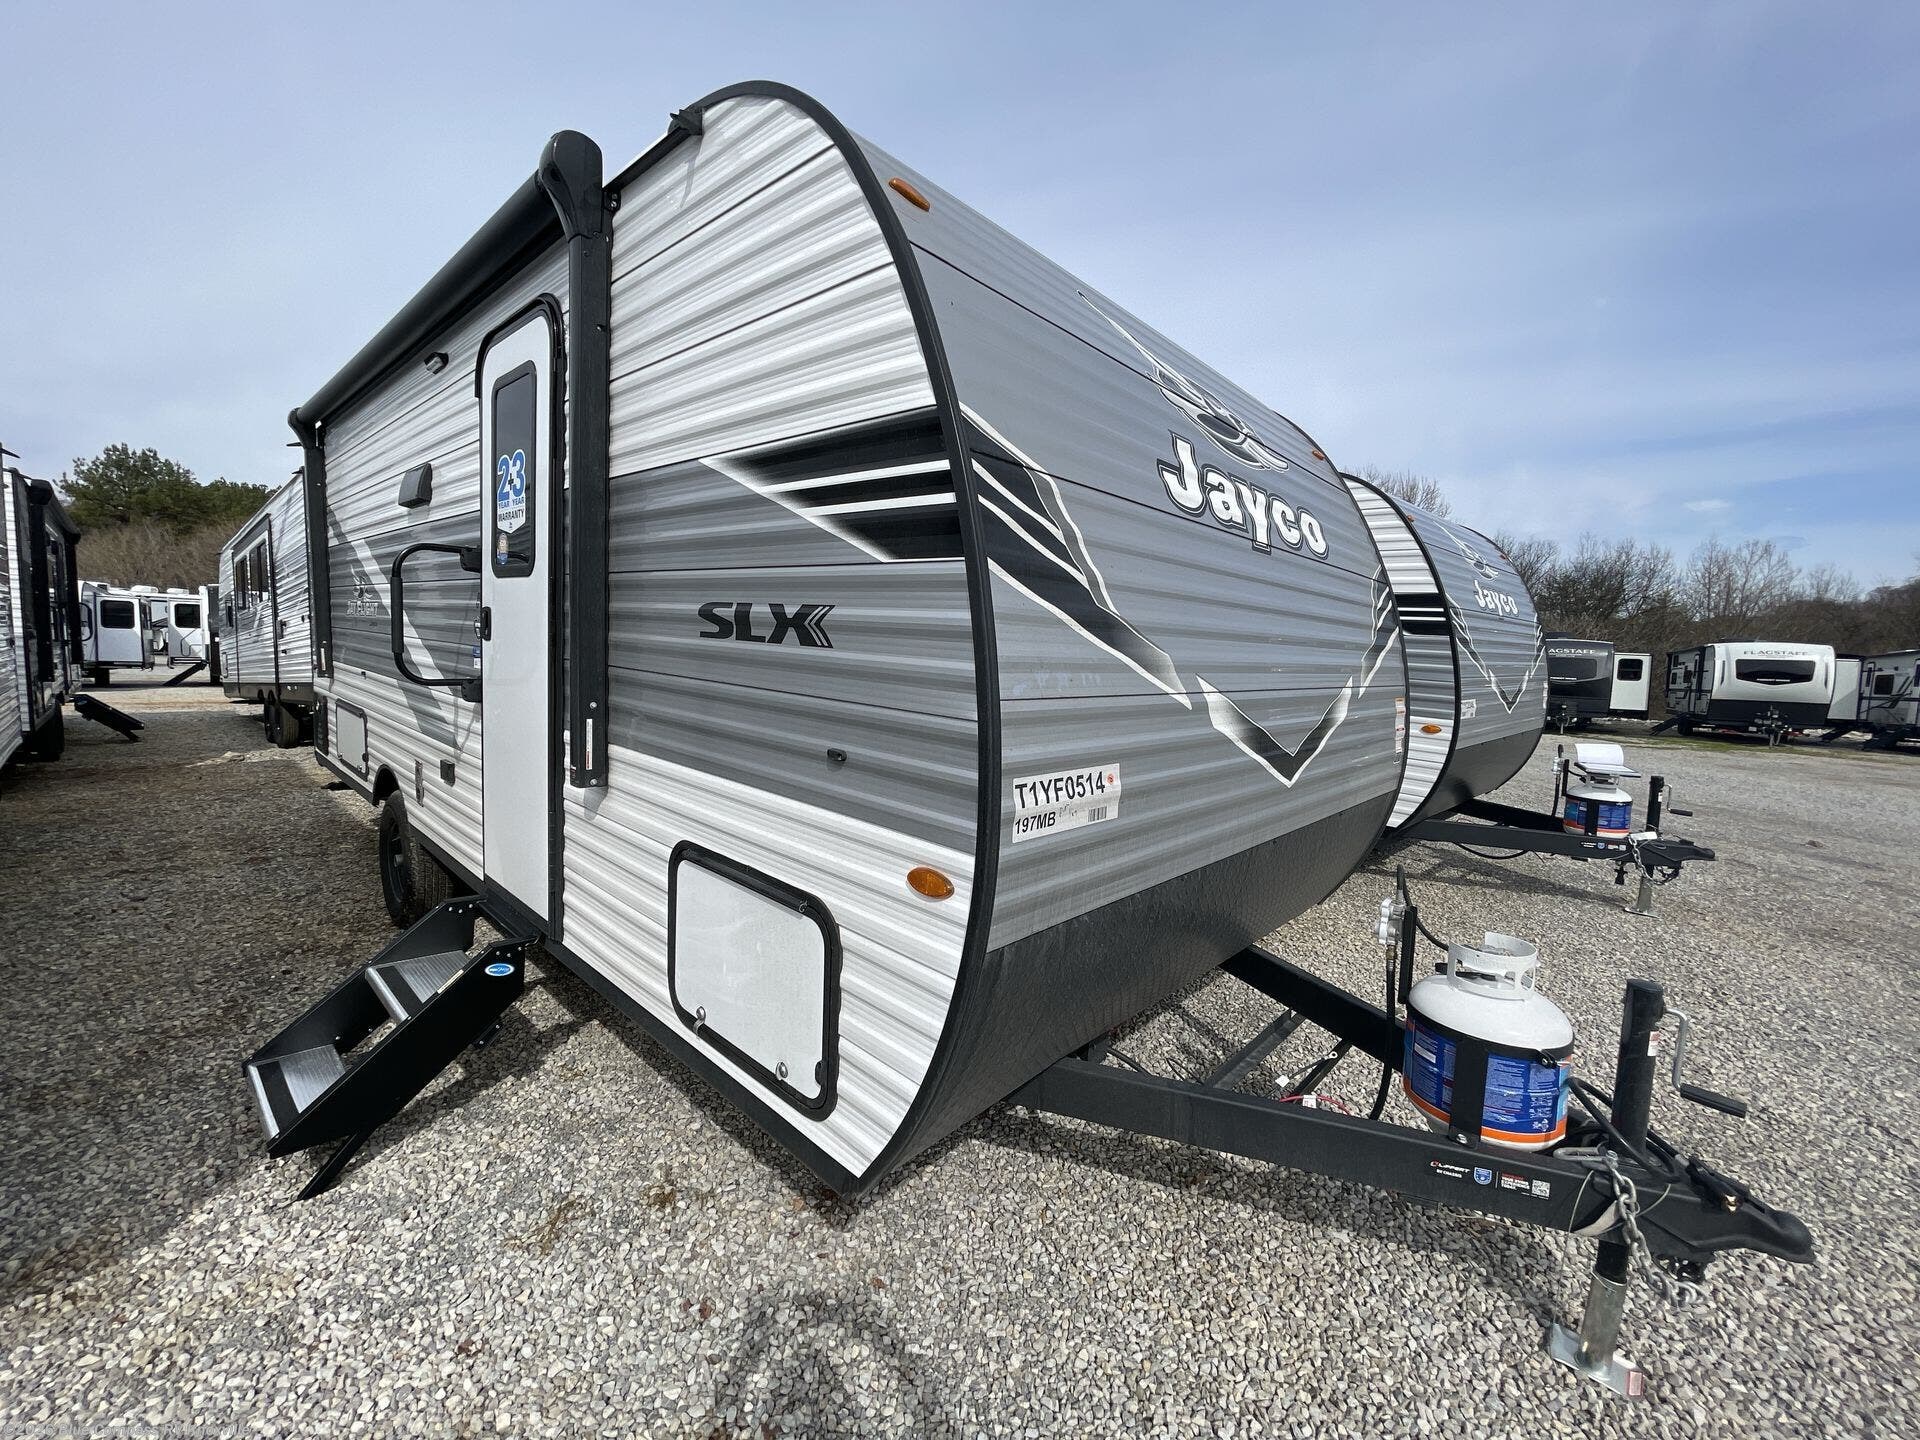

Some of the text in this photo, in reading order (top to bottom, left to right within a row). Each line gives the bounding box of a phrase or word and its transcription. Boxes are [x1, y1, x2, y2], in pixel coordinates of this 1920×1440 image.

[511, 496, 525, 506] YEAR
[1157, 431, 1329, 558] Jayco
[498, 508, 525, 522] WARRANTY
[1474, 579, 1519, 616] Jayco
[697, 601, 836, 648] SLX
[1014, 771, 1106, 809] T1YF0514
[1014, 811, 1056, 835] 197MB
